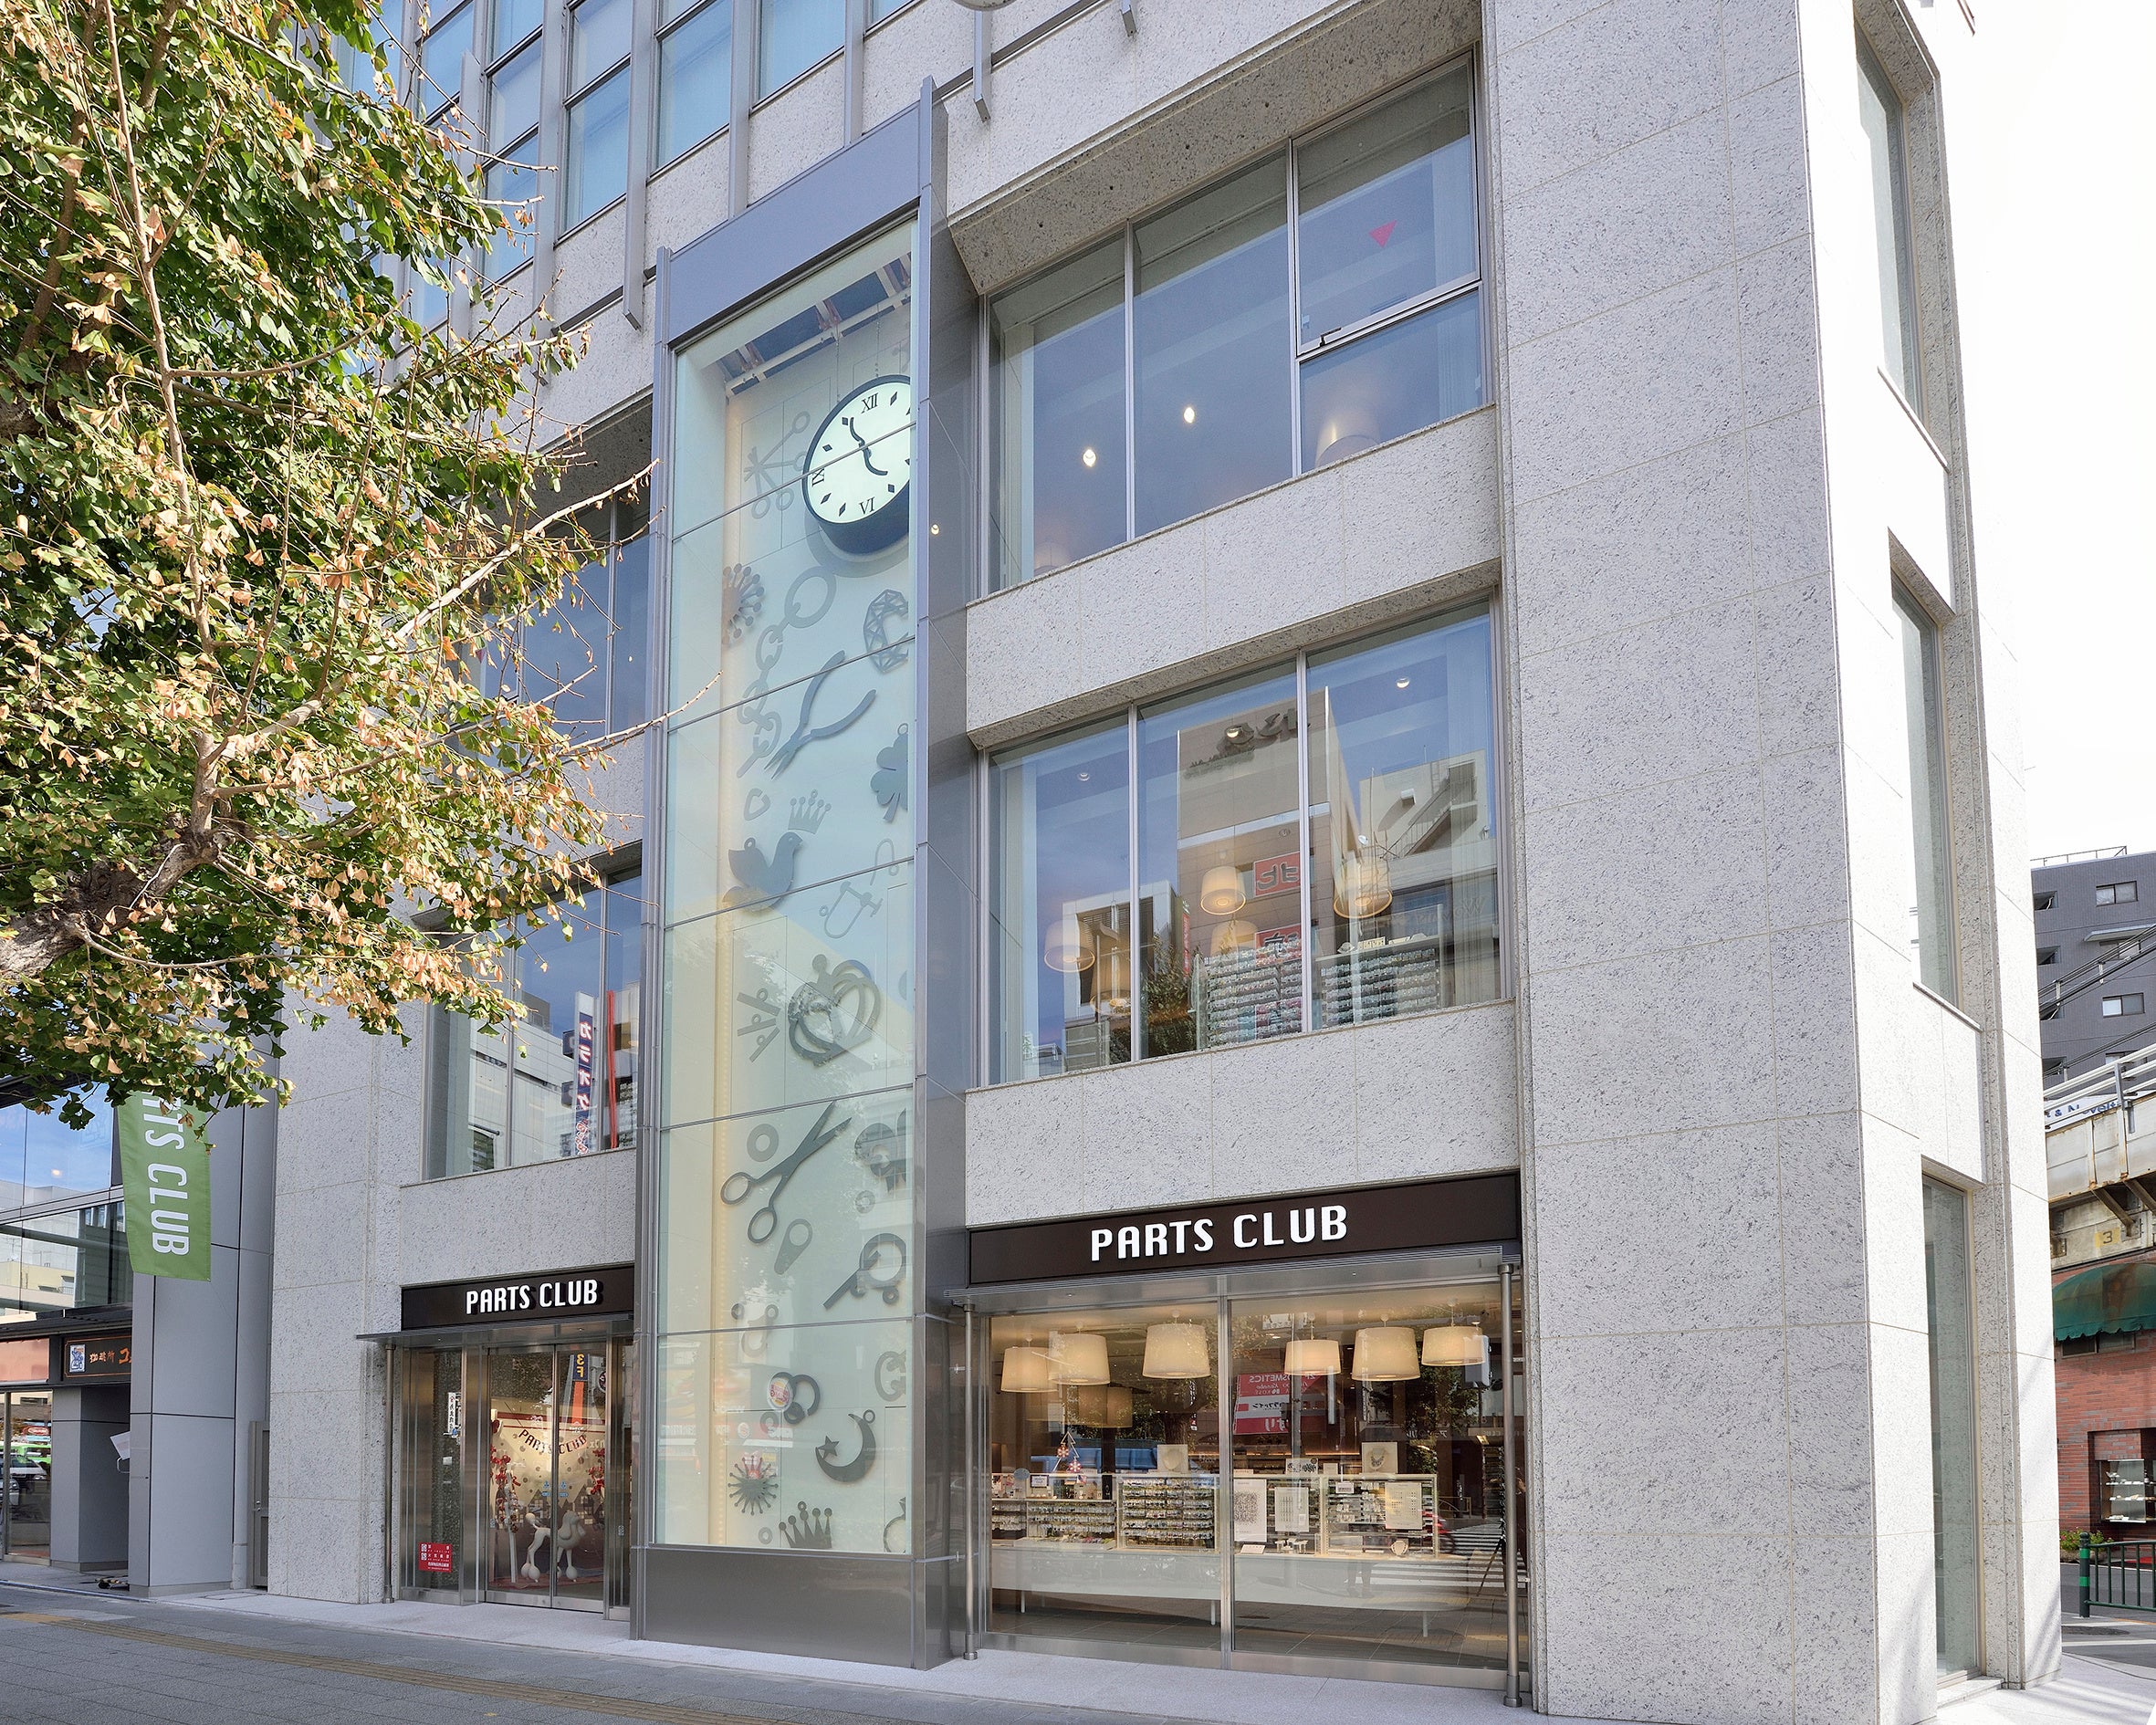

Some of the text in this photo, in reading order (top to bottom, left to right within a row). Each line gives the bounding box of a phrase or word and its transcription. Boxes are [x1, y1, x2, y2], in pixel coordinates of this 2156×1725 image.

[862, 393, 878, 413] XII
[860, 497, 874, 514] VI
[147, 1162, 190, 1257] CLUB
[1091, 1205, 1347, 1261] PARTS CLUB
[2102, 1230, 2113, 1244] 3
[466, 1279, 598, 1314] PARTS CLUB
[119, 1347, 131, 1364] コ
